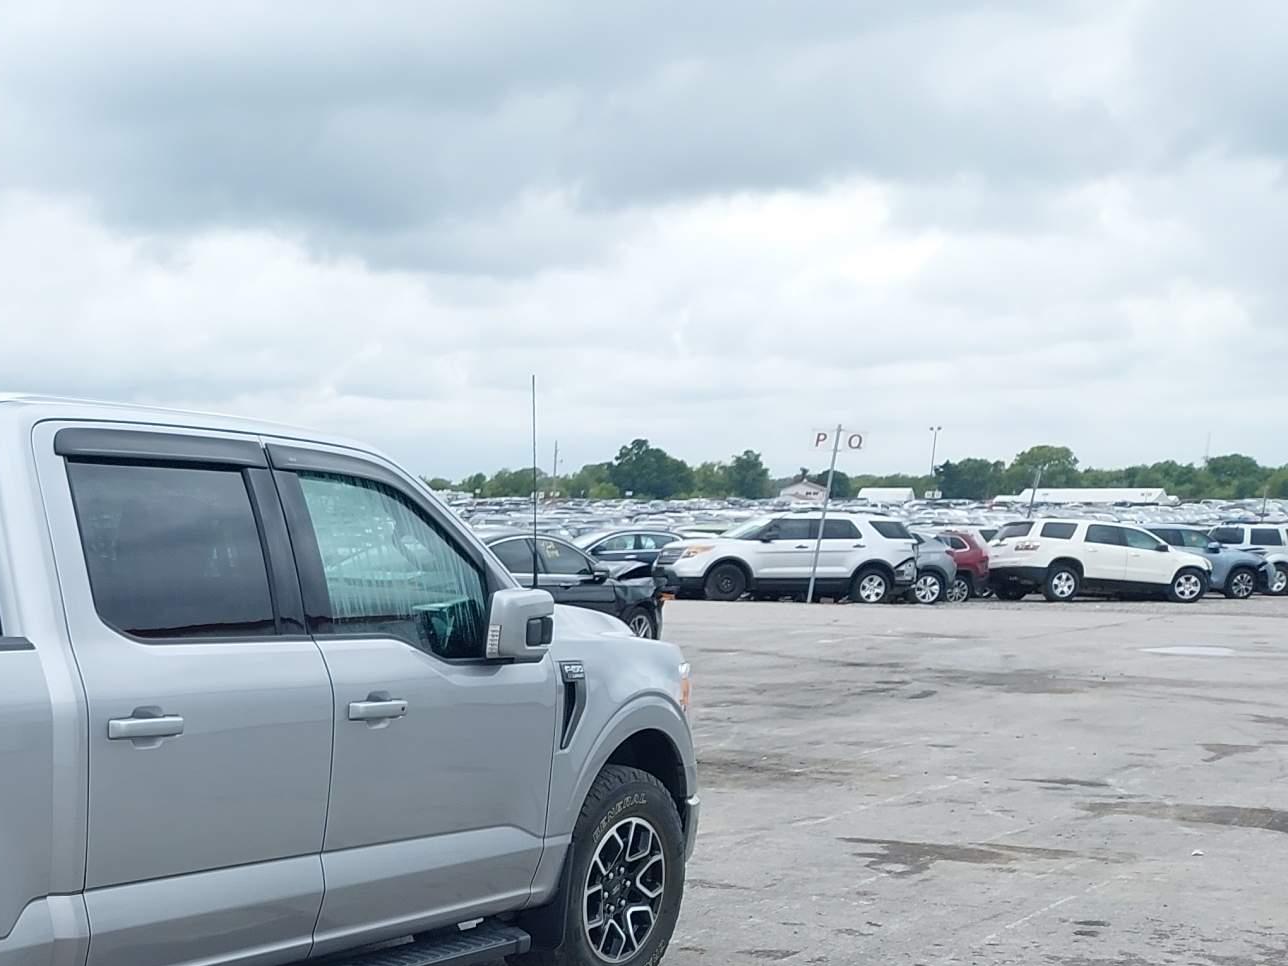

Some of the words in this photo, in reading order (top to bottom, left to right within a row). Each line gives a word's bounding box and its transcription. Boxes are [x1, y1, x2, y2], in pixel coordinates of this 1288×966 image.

[815, 432, 828, 448] P
[848, 434, 863, 450] Q
[592, 792, 648, 843] GENERAL
